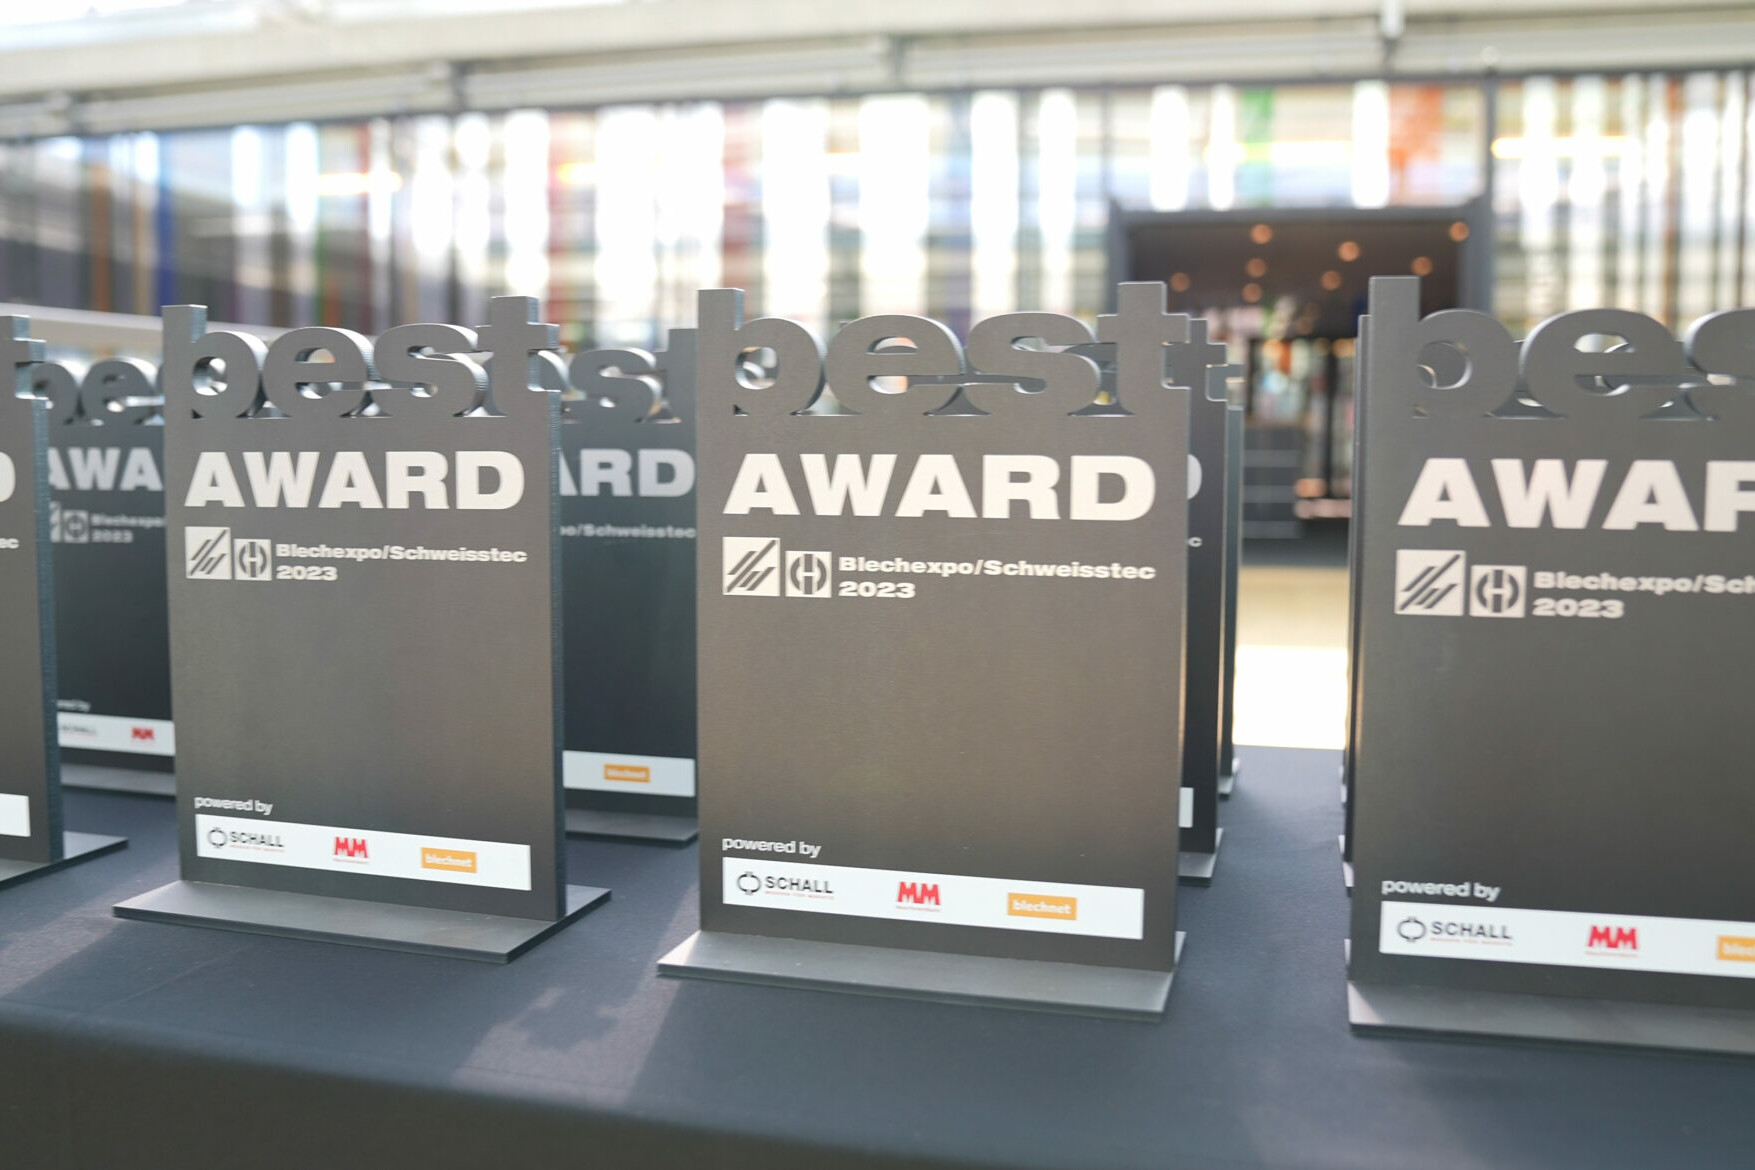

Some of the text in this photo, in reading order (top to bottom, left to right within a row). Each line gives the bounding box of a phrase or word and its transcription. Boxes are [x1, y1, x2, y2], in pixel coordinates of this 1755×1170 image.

[698, 281, 1191, 418] best
[185, 450, 525, 510] AWARD
[722, 453, 1156, 522] AWARD
[276, 543, 528, 564] Blechexpo/Schweisstec
[276, 565, 338, 581] 2023
[838, 556, 1157, 581] Blechexpo/Schweisstec
[838, 579, 917, 600] 2023
[1532, 597, 1625, 619] 2023
[194, 796, 273, 816] powered by
[721, 838, 822, 859] powered by
[764, 874, 835, 895] SCHALL
[1382, 879, 1501, 902] powered by
[1012, 898, 1072, 916] blechnet
[1430, 920, 1514, 941] SCHALL
